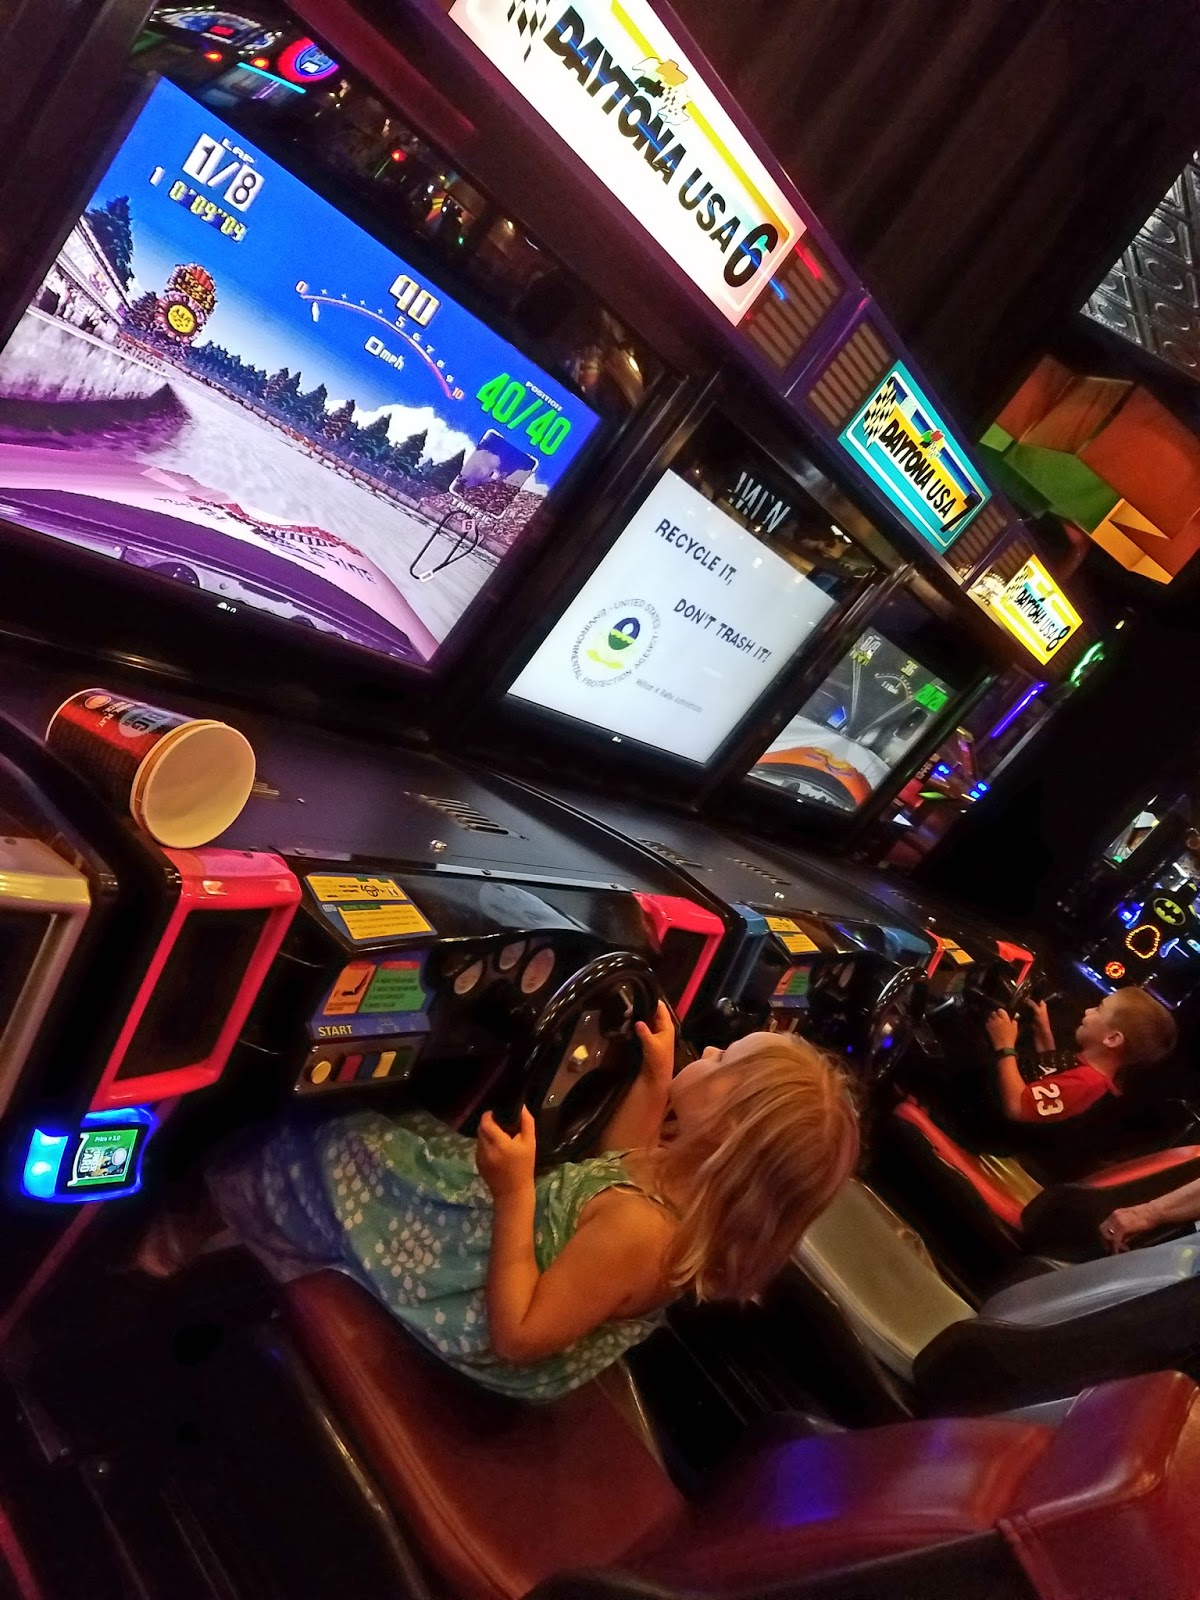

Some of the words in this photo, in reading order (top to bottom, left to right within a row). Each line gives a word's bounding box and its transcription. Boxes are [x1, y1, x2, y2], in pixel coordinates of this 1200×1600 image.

[543, 5, 687, 185] DAYTONA
[678, 168, 741, 254] USA
[723, 223, 779, 288] 6
[185, 137, 262, 208] 1/8
[395, 315, 407, 329] 5
[411, 332, 422, 343] 6
[425, 344, 435, 355] 7
[525, 380, 563, 411] POSITION
[476, 372, 571, 456] 40/40
[879, 419, 936, 492] DAYTONA
[926, 478, 958, 519] USA
[655, 518, 722, 572] RECYCLE
[718, 563, 738, 585] IT,
[613, 598, 646, 610] UNITED
[645, 603, 661, 631] STATES
[1014, 588, 1047, 626] DAYTONA
[674, 598, 716, 630] DON'T
[715, 622, 756, 654] TRASH
[752, 645, 772, 663] IT!
[1039, 617, 1060, 640] USA
[1046, 625, 1071, 652] 8
[318, 1025, 353, 1038] START
[1031, 1083, 1064, 1117] 23
